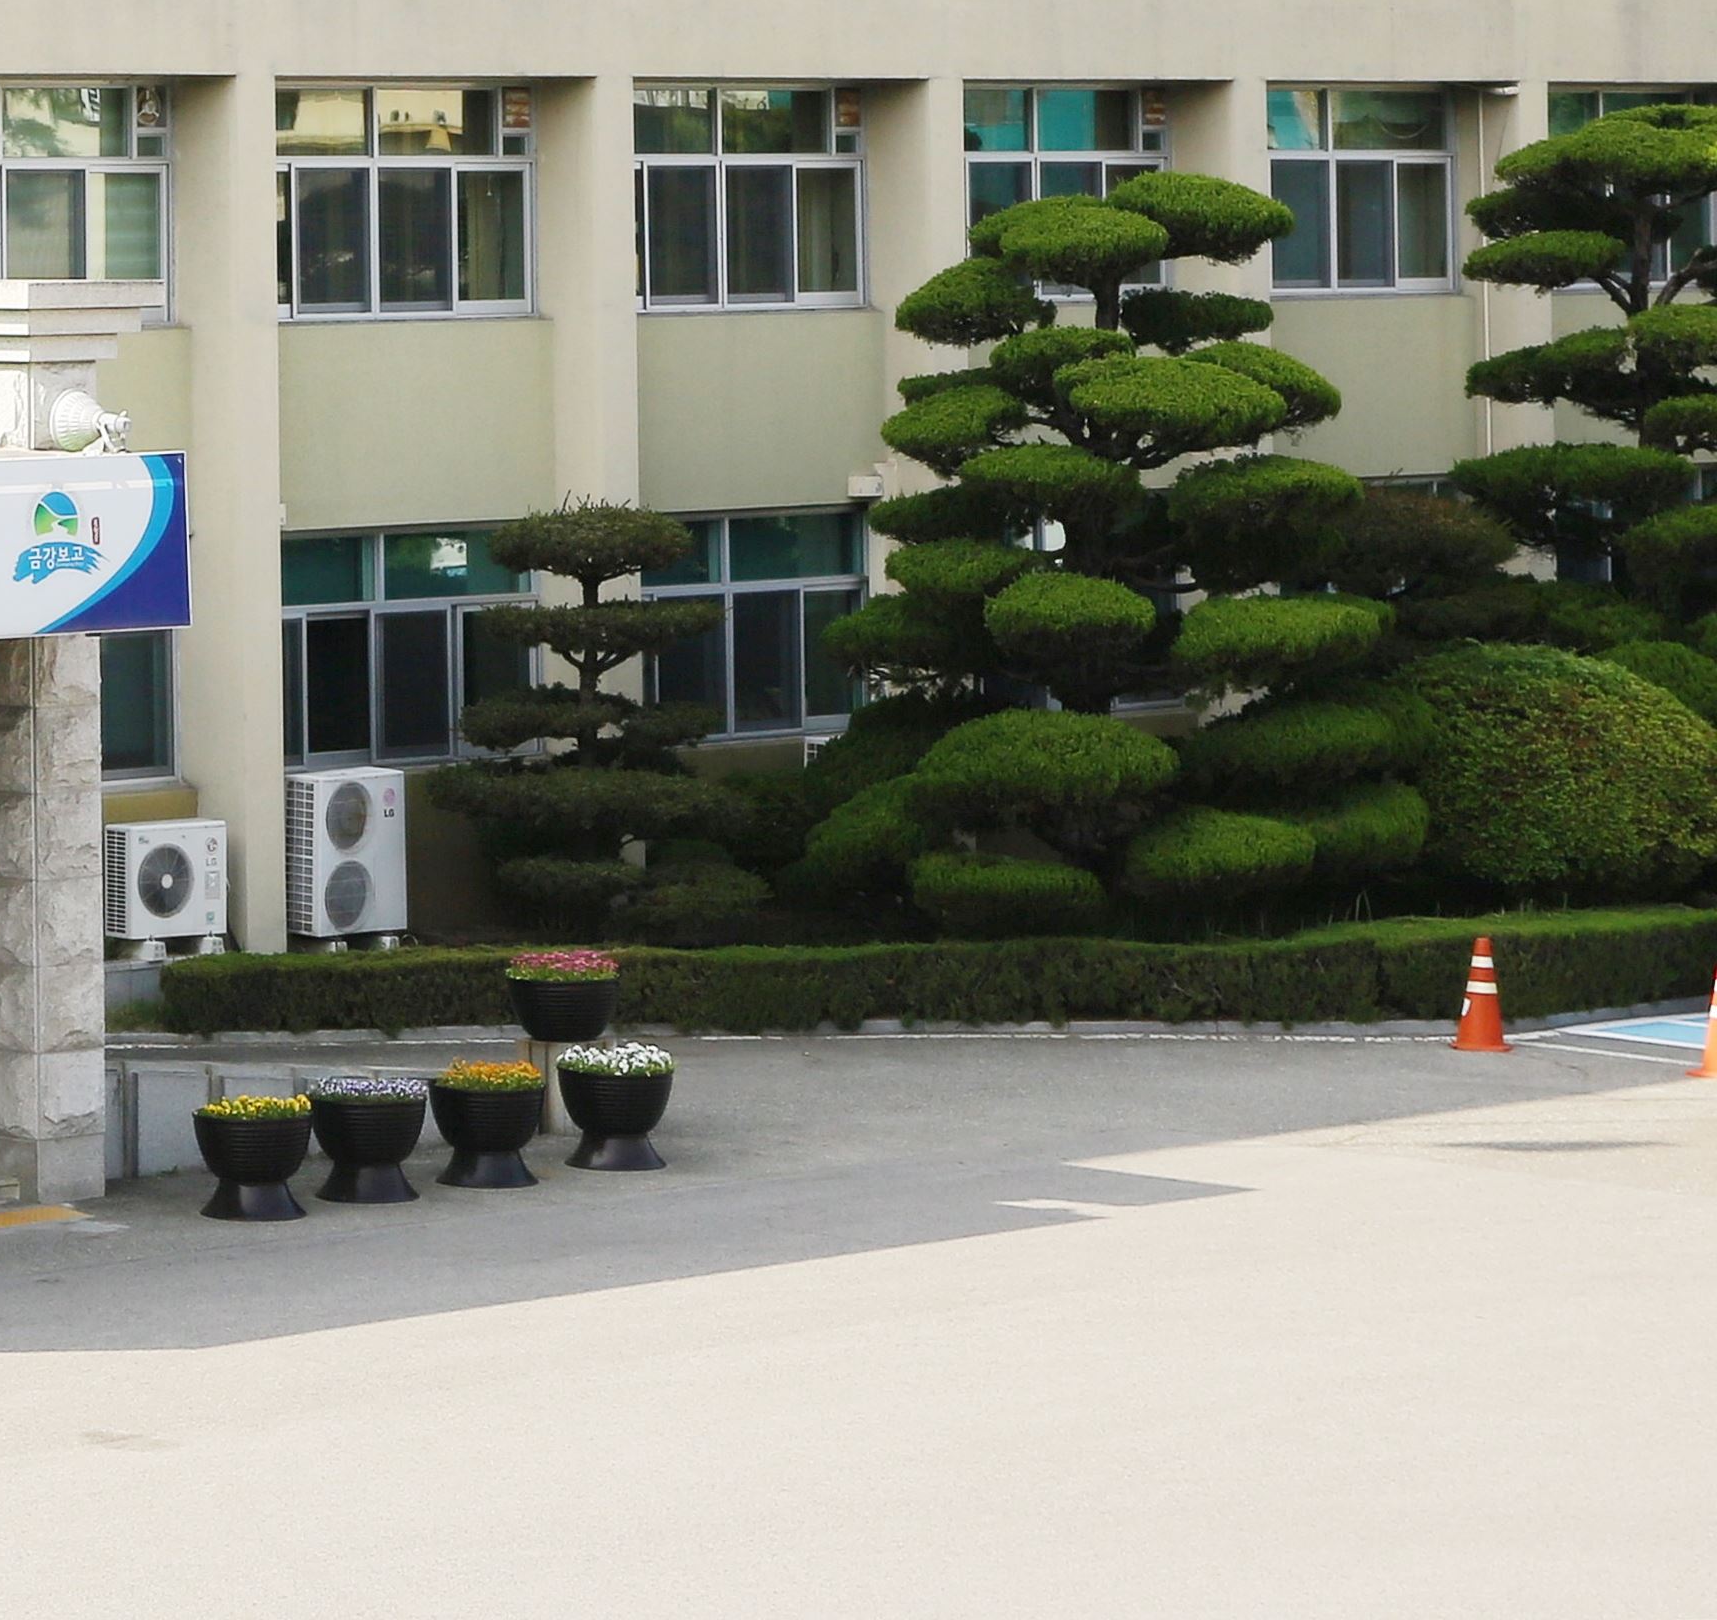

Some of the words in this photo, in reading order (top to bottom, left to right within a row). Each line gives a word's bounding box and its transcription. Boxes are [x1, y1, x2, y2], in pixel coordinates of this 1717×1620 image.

[28, 545, 85, 570] 금강보고
[384, 808, 395, 818] LG
[205, 857, 218, 867] LG
